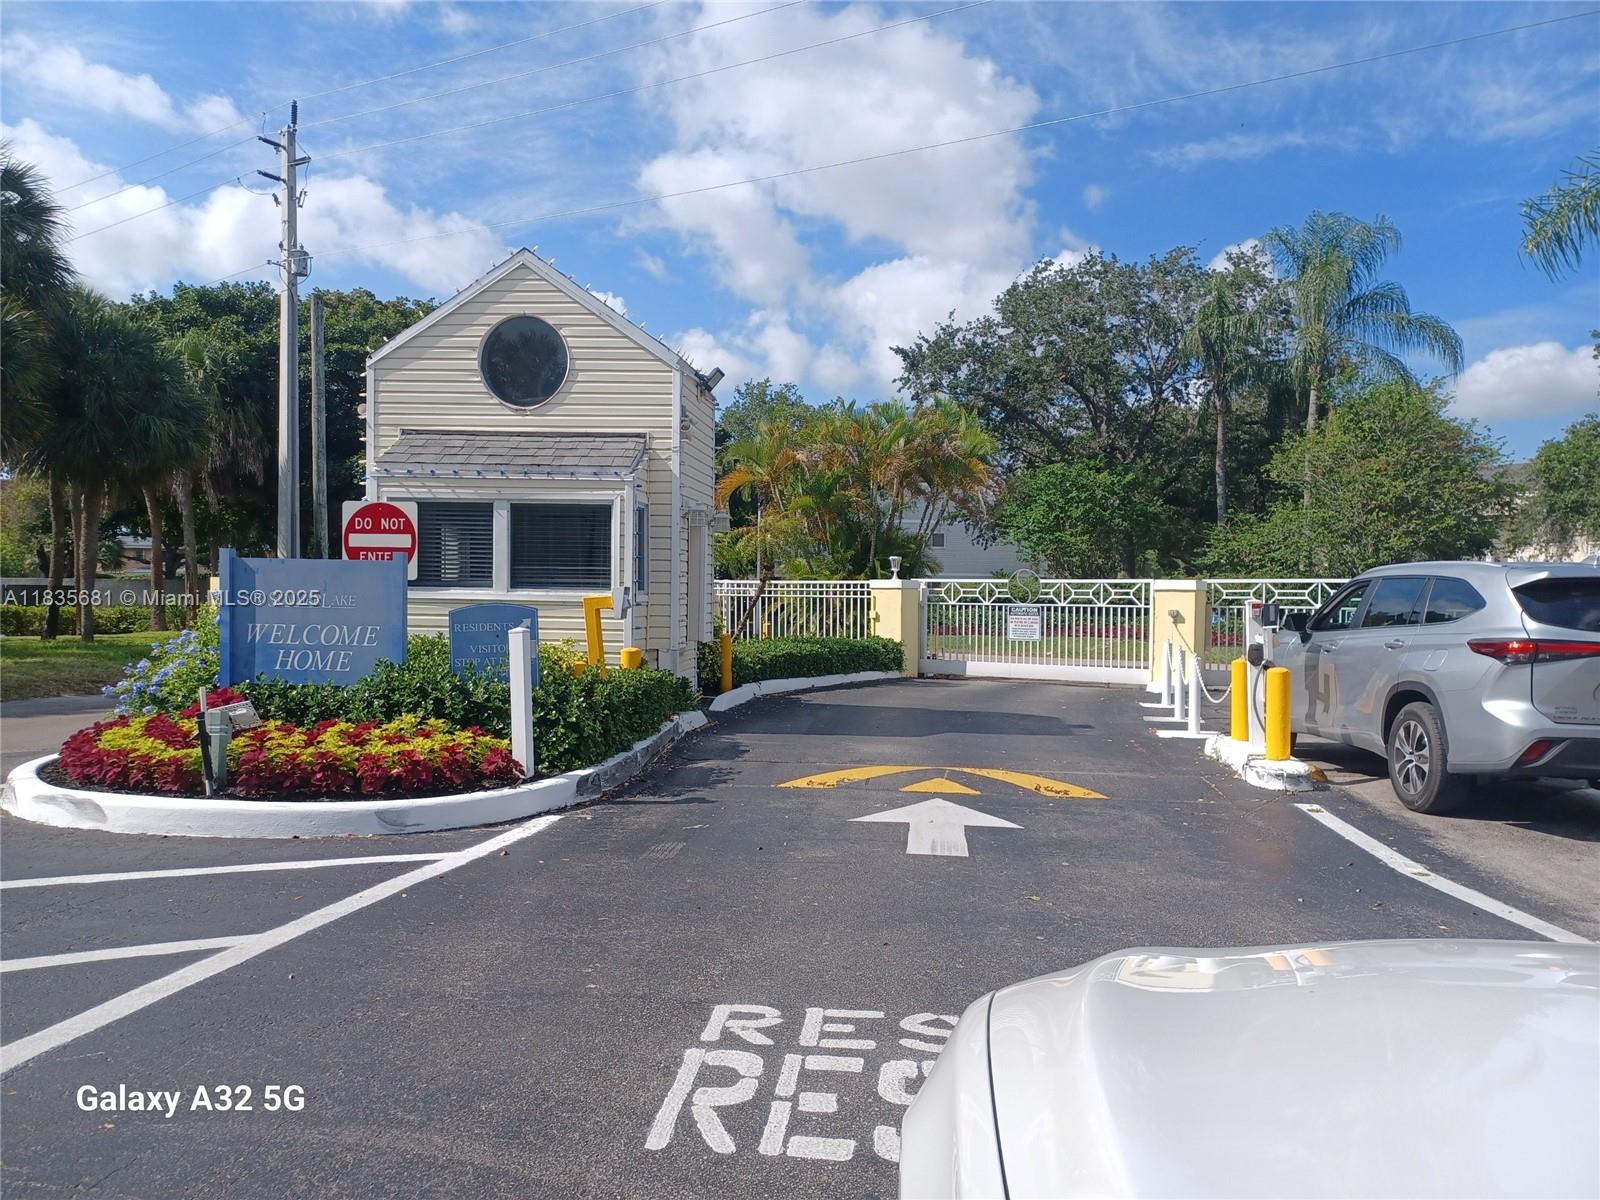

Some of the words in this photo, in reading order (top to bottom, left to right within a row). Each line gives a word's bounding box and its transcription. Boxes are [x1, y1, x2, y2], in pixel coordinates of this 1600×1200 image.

[355, 517, 372, 530] DO
[381, 517, 406, 530] NOT
[360, 552, 392, 561] ENTE
[454, 622, 514, 633] RESIDENTS
[247, 623, 380, 647] WELCOME
[470, 644, 509, 654] VISITO
[274, 649, 353, 672] HOME
